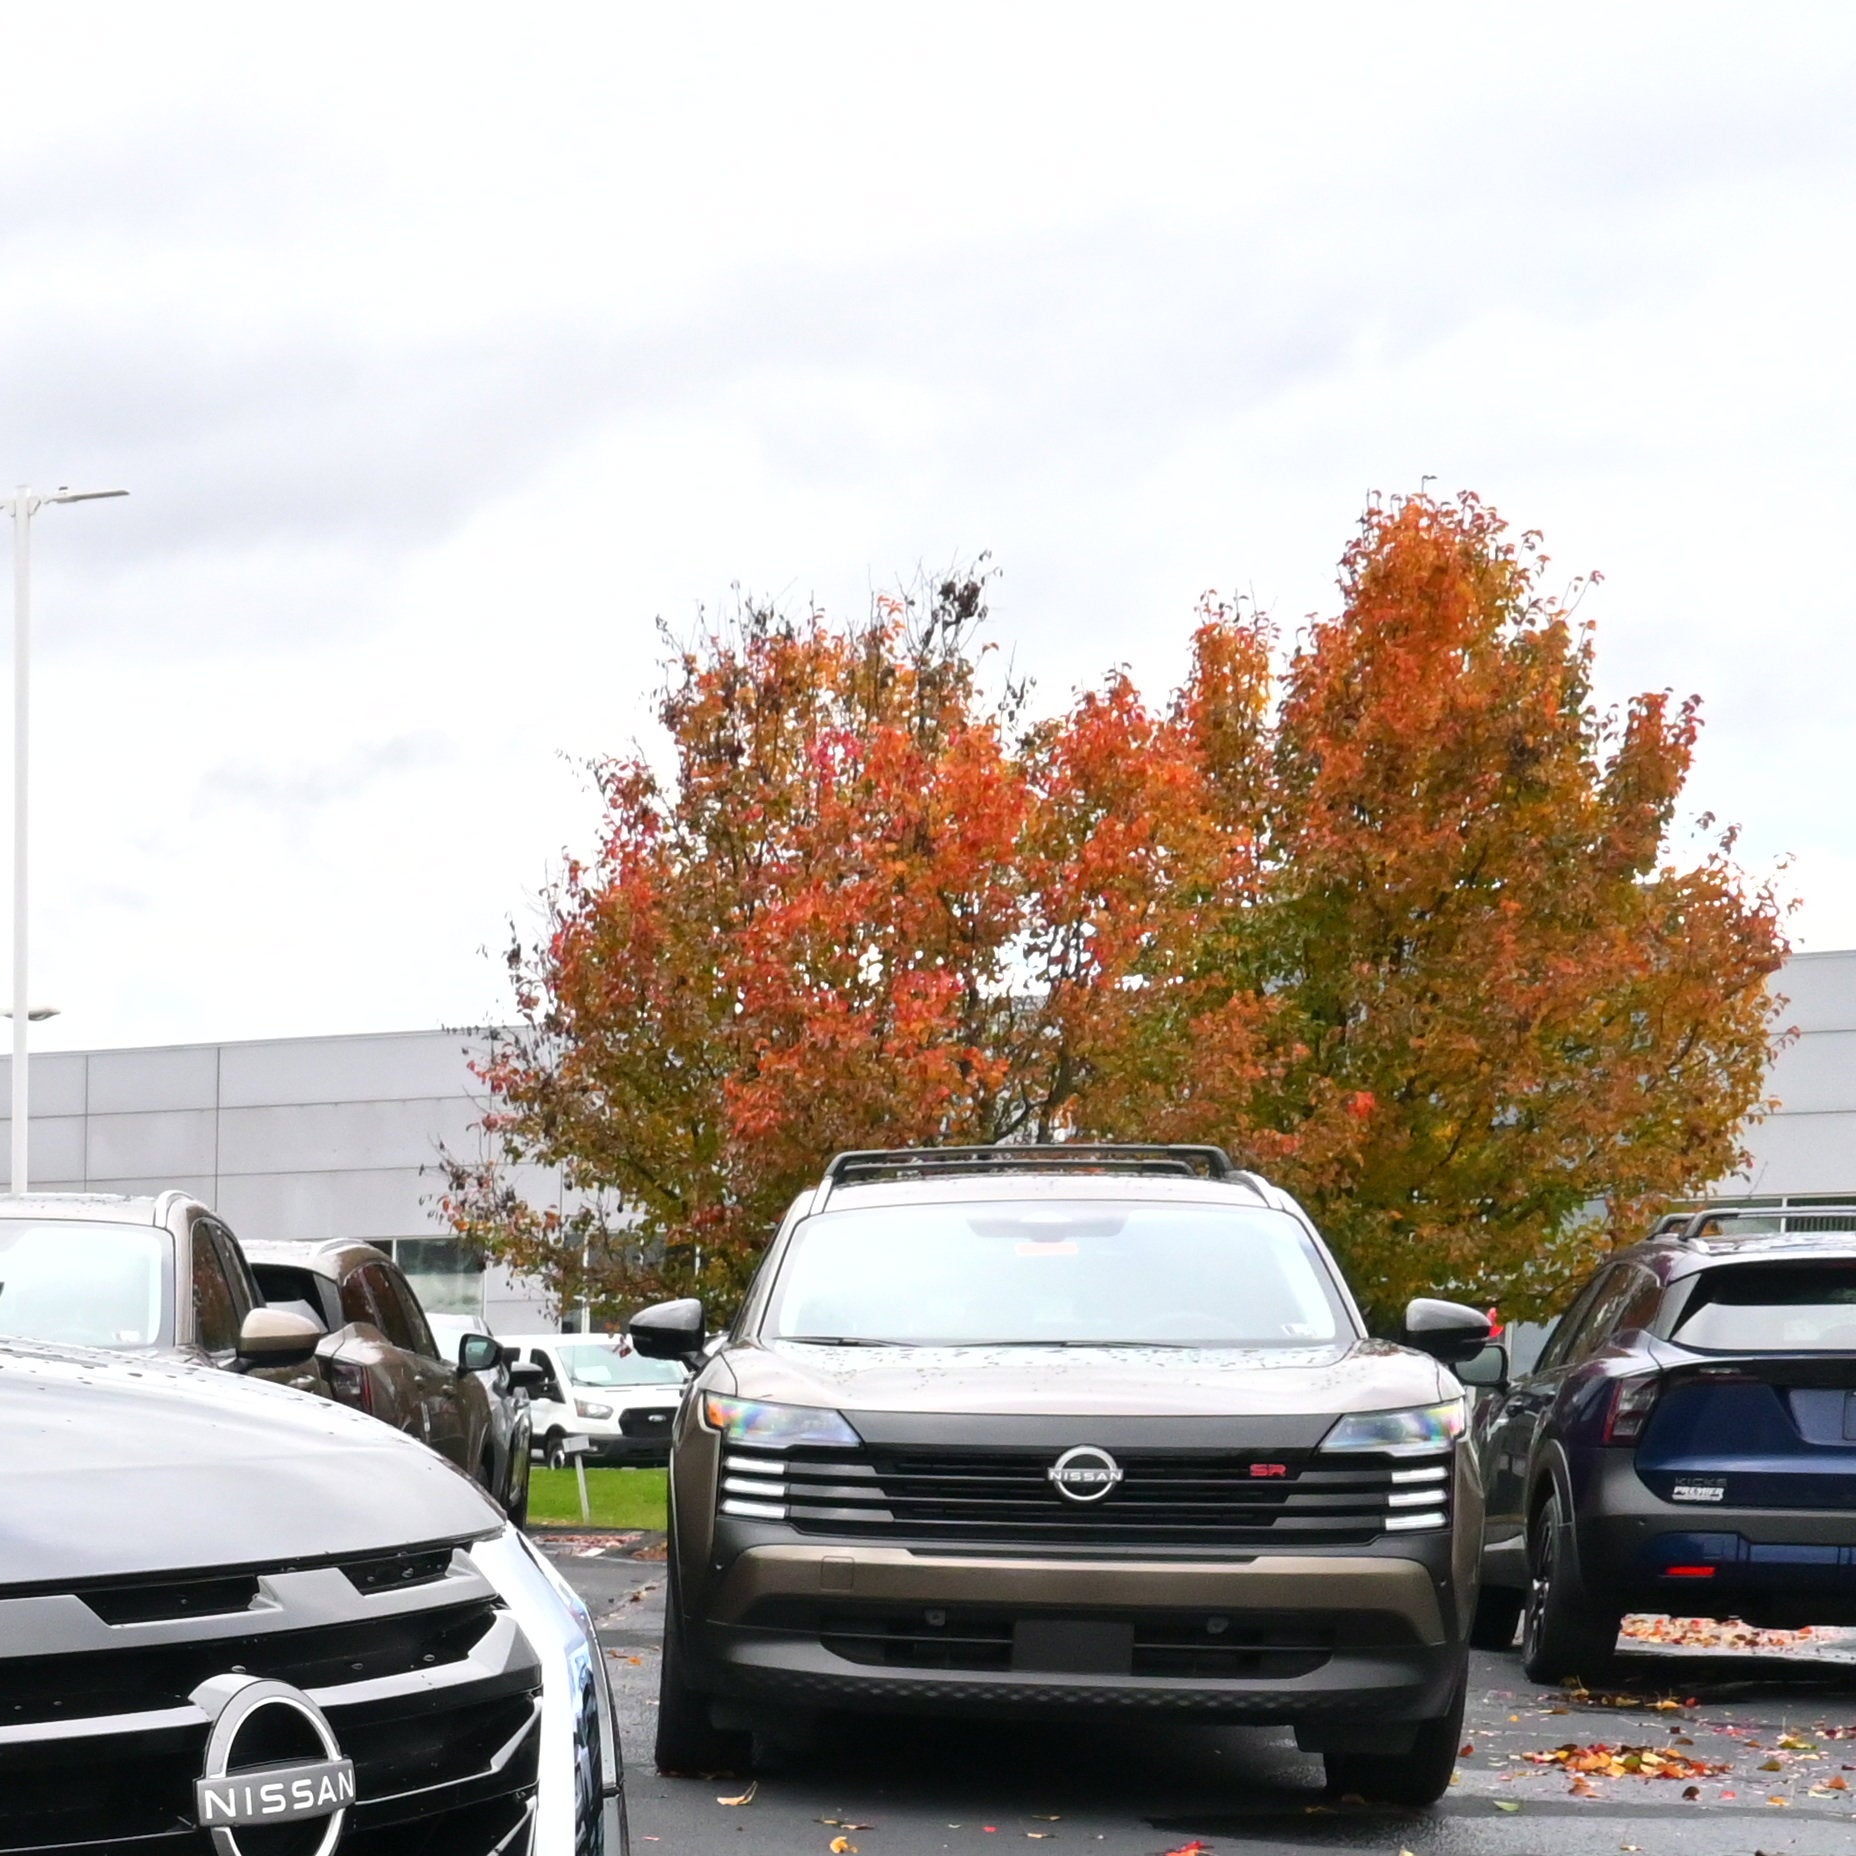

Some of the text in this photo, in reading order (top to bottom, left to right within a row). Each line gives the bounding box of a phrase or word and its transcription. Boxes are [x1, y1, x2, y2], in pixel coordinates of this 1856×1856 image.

[1049, 1471, 1122, 1481] NISSAN
[1249, 1463, 1287, 1477] SR
[1675, 1477, 1727, 1487] KICKS
[204, 1769, 354, 1819] NISSAN
